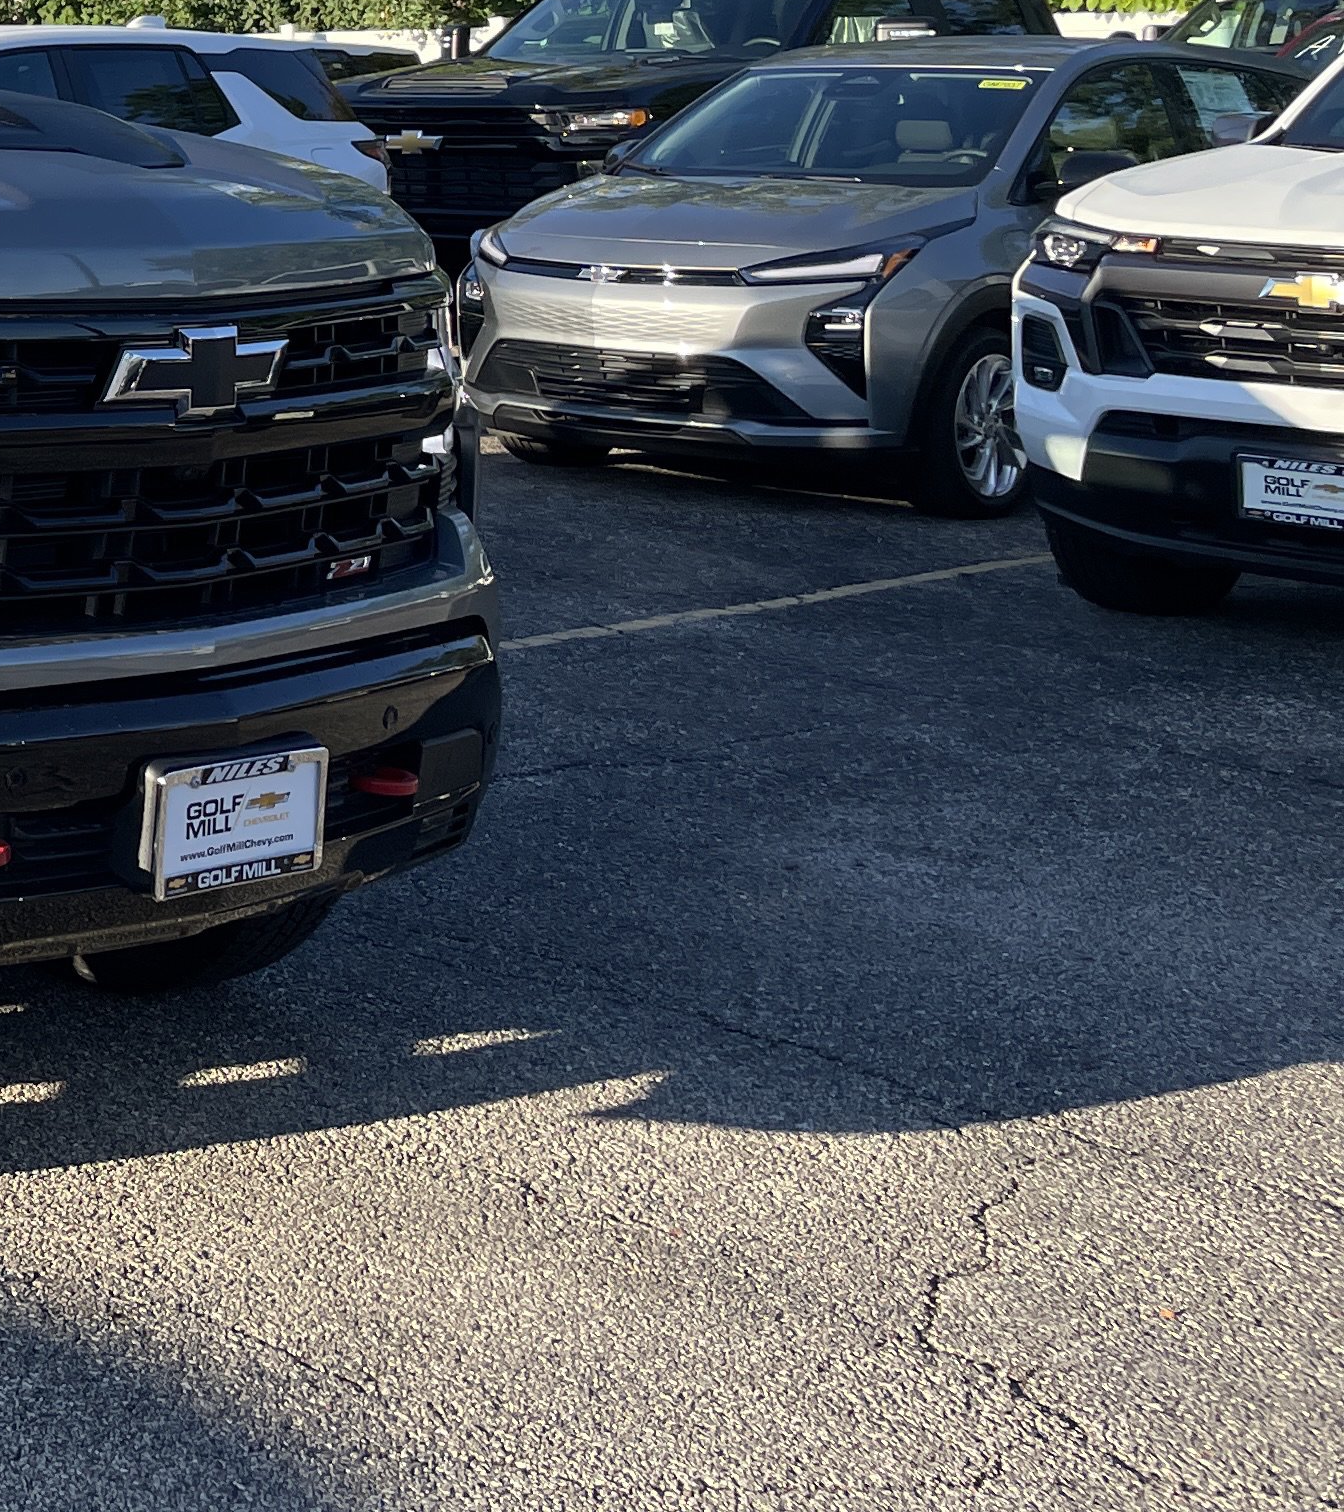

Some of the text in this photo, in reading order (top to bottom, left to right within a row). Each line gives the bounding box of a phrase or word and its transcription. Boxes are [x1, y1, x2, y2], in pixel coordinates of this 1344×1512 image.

[1274, 460, 1337, 475] NILES
[1264, 475, 1310, 489] GOLF
[1265, 485, 1304, 498] MILL
[1273, 513, 1343, 529] GOLF MILL
[326, 555, 372, 580] Z71
[208, 756, 284, 783] NILES
[187, 794, 244, 820] GOLF
[243, 811, 289, 827] CHEVROLET
[186, 815, 231, 840] MILL
[180, 833, 294, 861] www.GolfMillChevy.com
[198, 860, 281, 888] GOLF MILL
